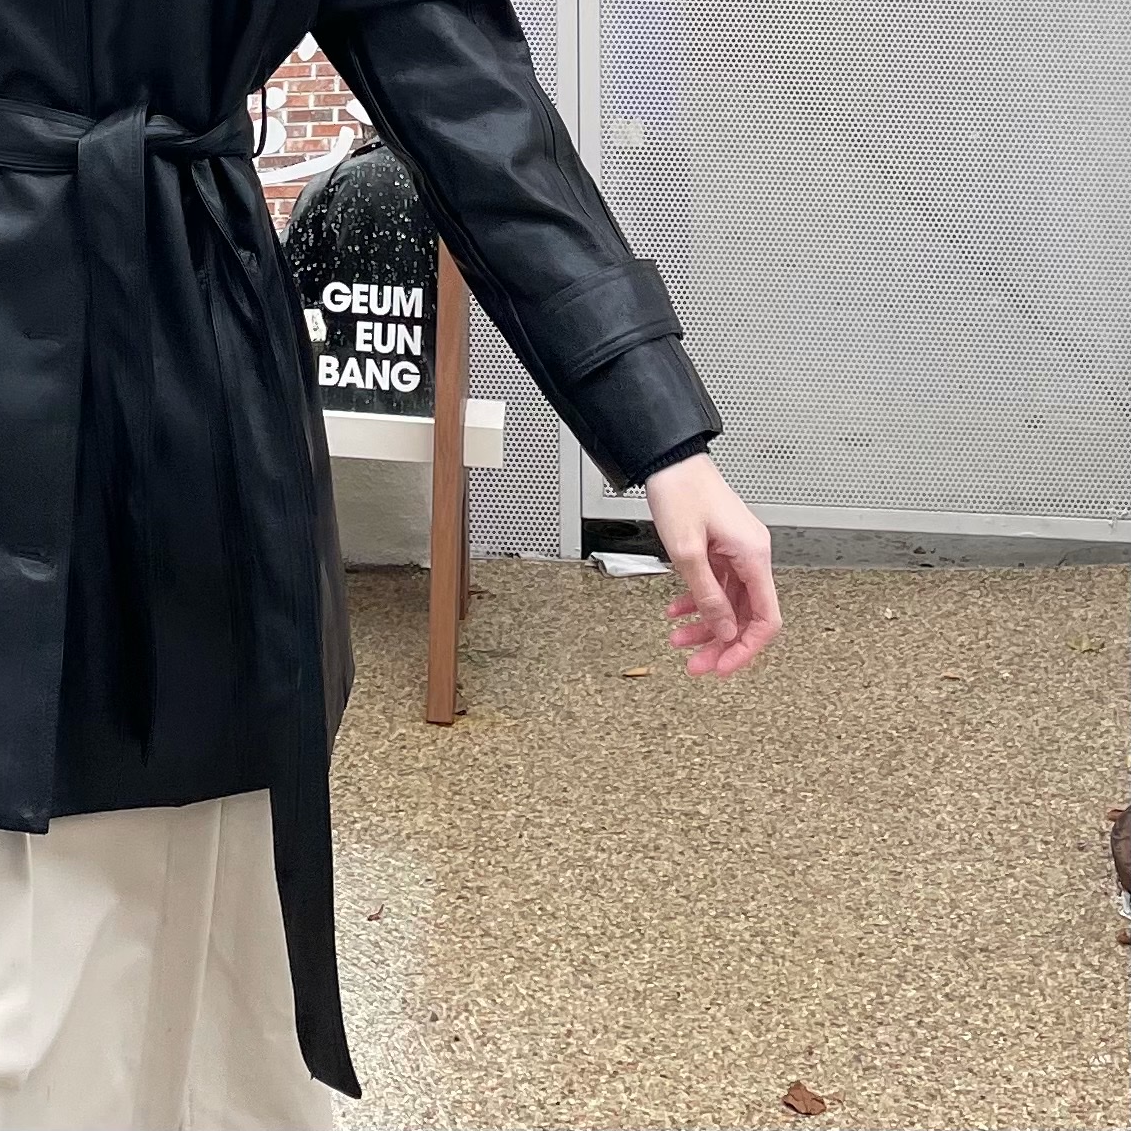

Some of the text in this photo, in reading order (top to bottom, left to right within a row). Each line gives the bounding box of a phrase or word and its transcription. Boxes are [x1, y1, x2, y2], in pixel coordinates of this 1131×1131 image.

[322, 281, 424, 318] GEUM
[355, 320, 422, 356] EUN
[318, 354, 421, 393] BANG
